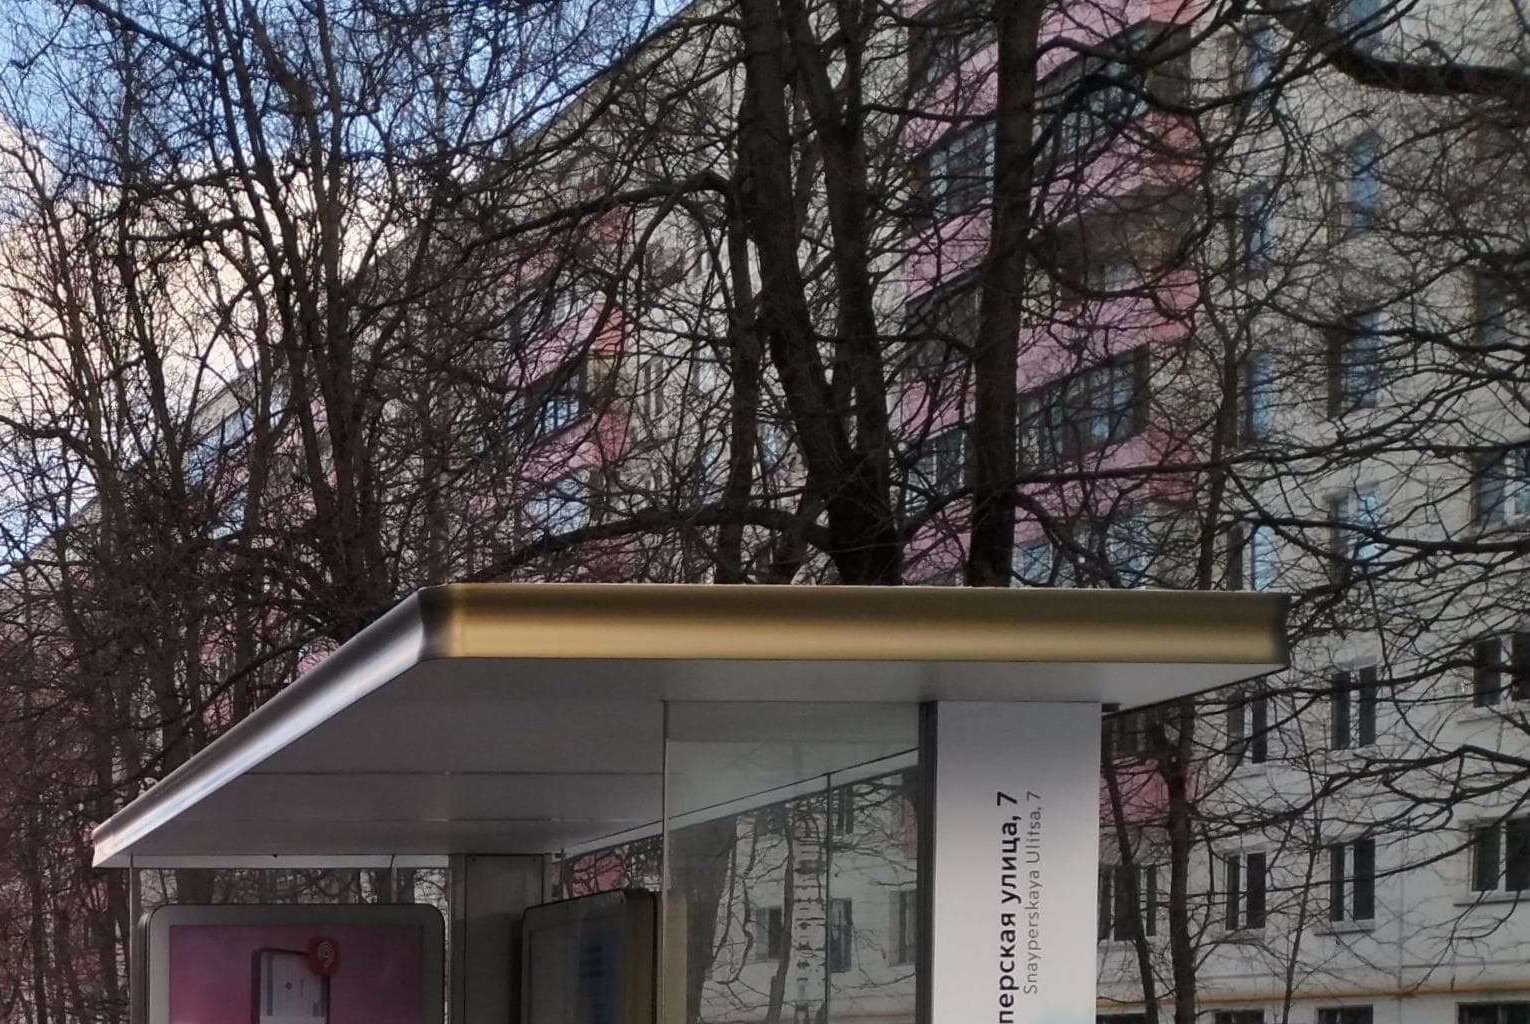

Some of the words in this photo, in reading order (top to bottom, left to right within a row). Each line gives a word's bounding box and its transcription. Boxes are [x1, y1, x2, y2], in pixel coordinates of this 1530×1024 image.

[997, 791, 1019, 807] 7
[1026, 791, 1041, 802] 7
[1001, 815, 1022, 904] улица,
[1025, 806, 1042, 864] Ulitsa,
[1023, 869, 1043, 994] Snayperskaya
